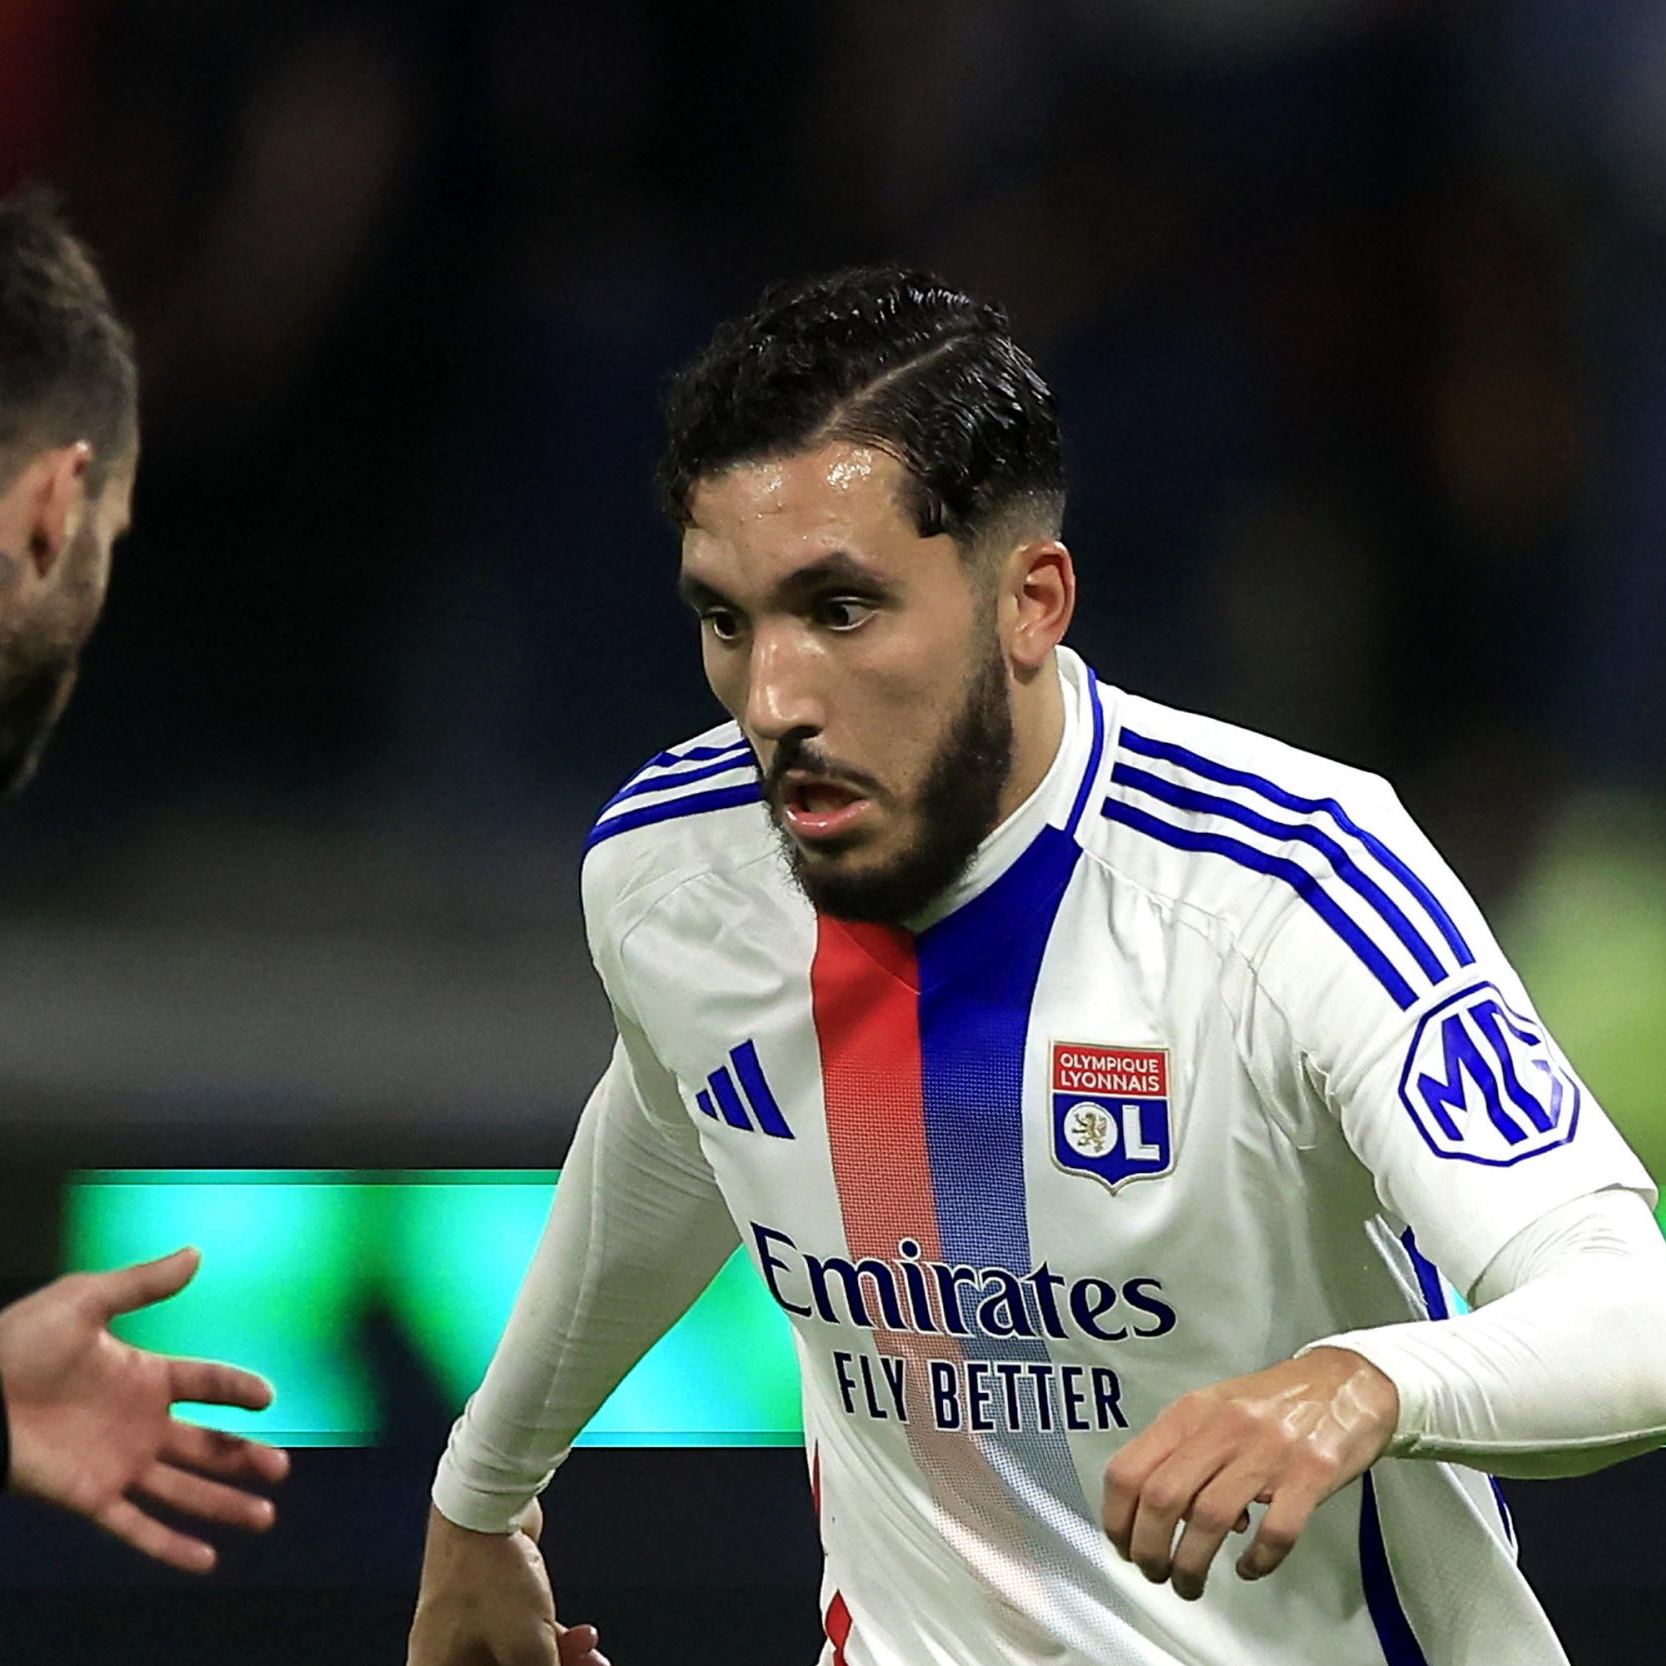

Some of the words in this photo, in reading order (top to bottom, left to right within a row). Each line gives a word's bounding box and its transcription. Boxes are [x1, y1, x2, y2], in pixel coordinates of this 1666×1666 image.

[1060, 1053, 1159, 1074] OLYMPIQUE
[1060, 1070, 1161, 1093] LYONNAIS
[1063, 1101, 1161, 1161] OL
[749, 1221, 1178, 1342] Emirates
[833, 1350, 910, 1424] FLY
[929, 1360, 1131, 1432] BETTER
